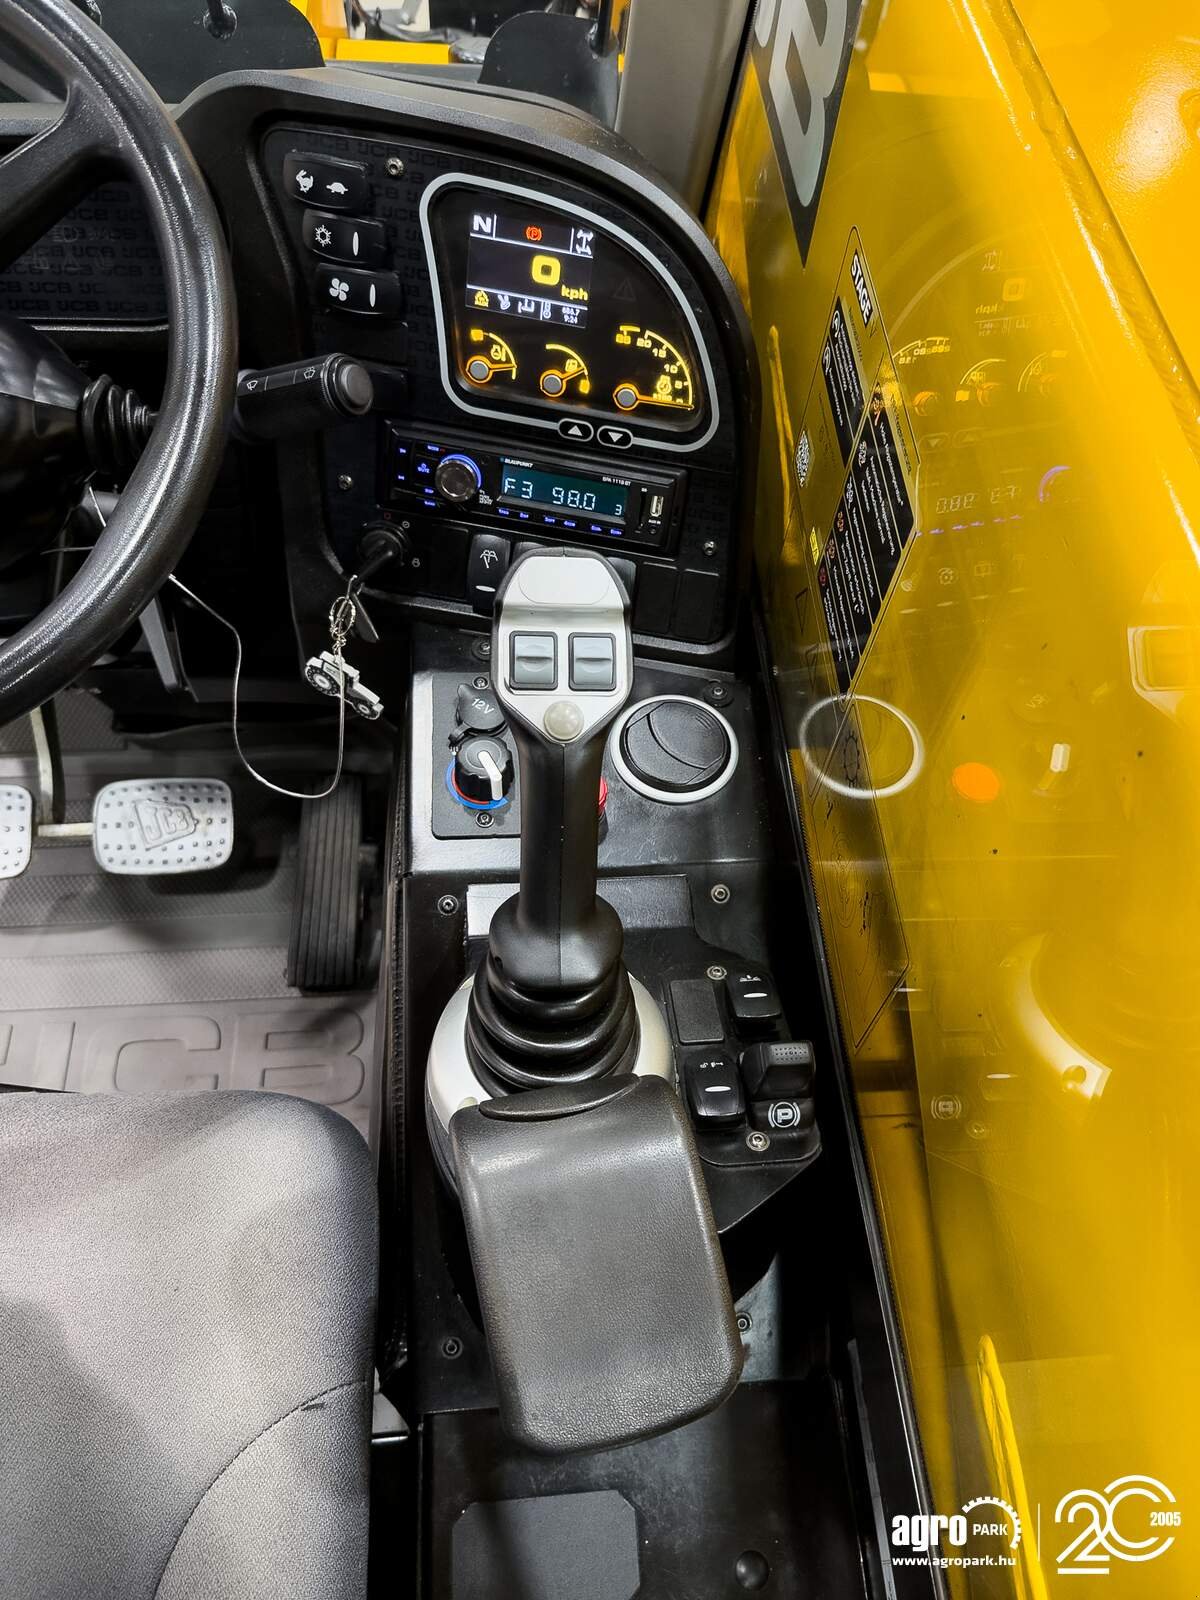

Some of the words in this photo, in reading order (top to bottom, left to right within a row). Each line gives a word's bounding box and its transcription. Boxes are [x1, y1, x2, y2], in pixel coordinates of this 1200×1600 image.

[473, 214, 492, 233] N
[531, 254, 562, 286] 0
[561, 284, 589, 301] kph
[851, 254, 872, 324] STAGE
[664, 363, 678, 374] 10
[504, 457, 534, 469] BLAUPUNKT
[552, 486, 597, 511] 98.0
[614, 504, 623, 516] 3
[470, 697, 495, 715] 12V
